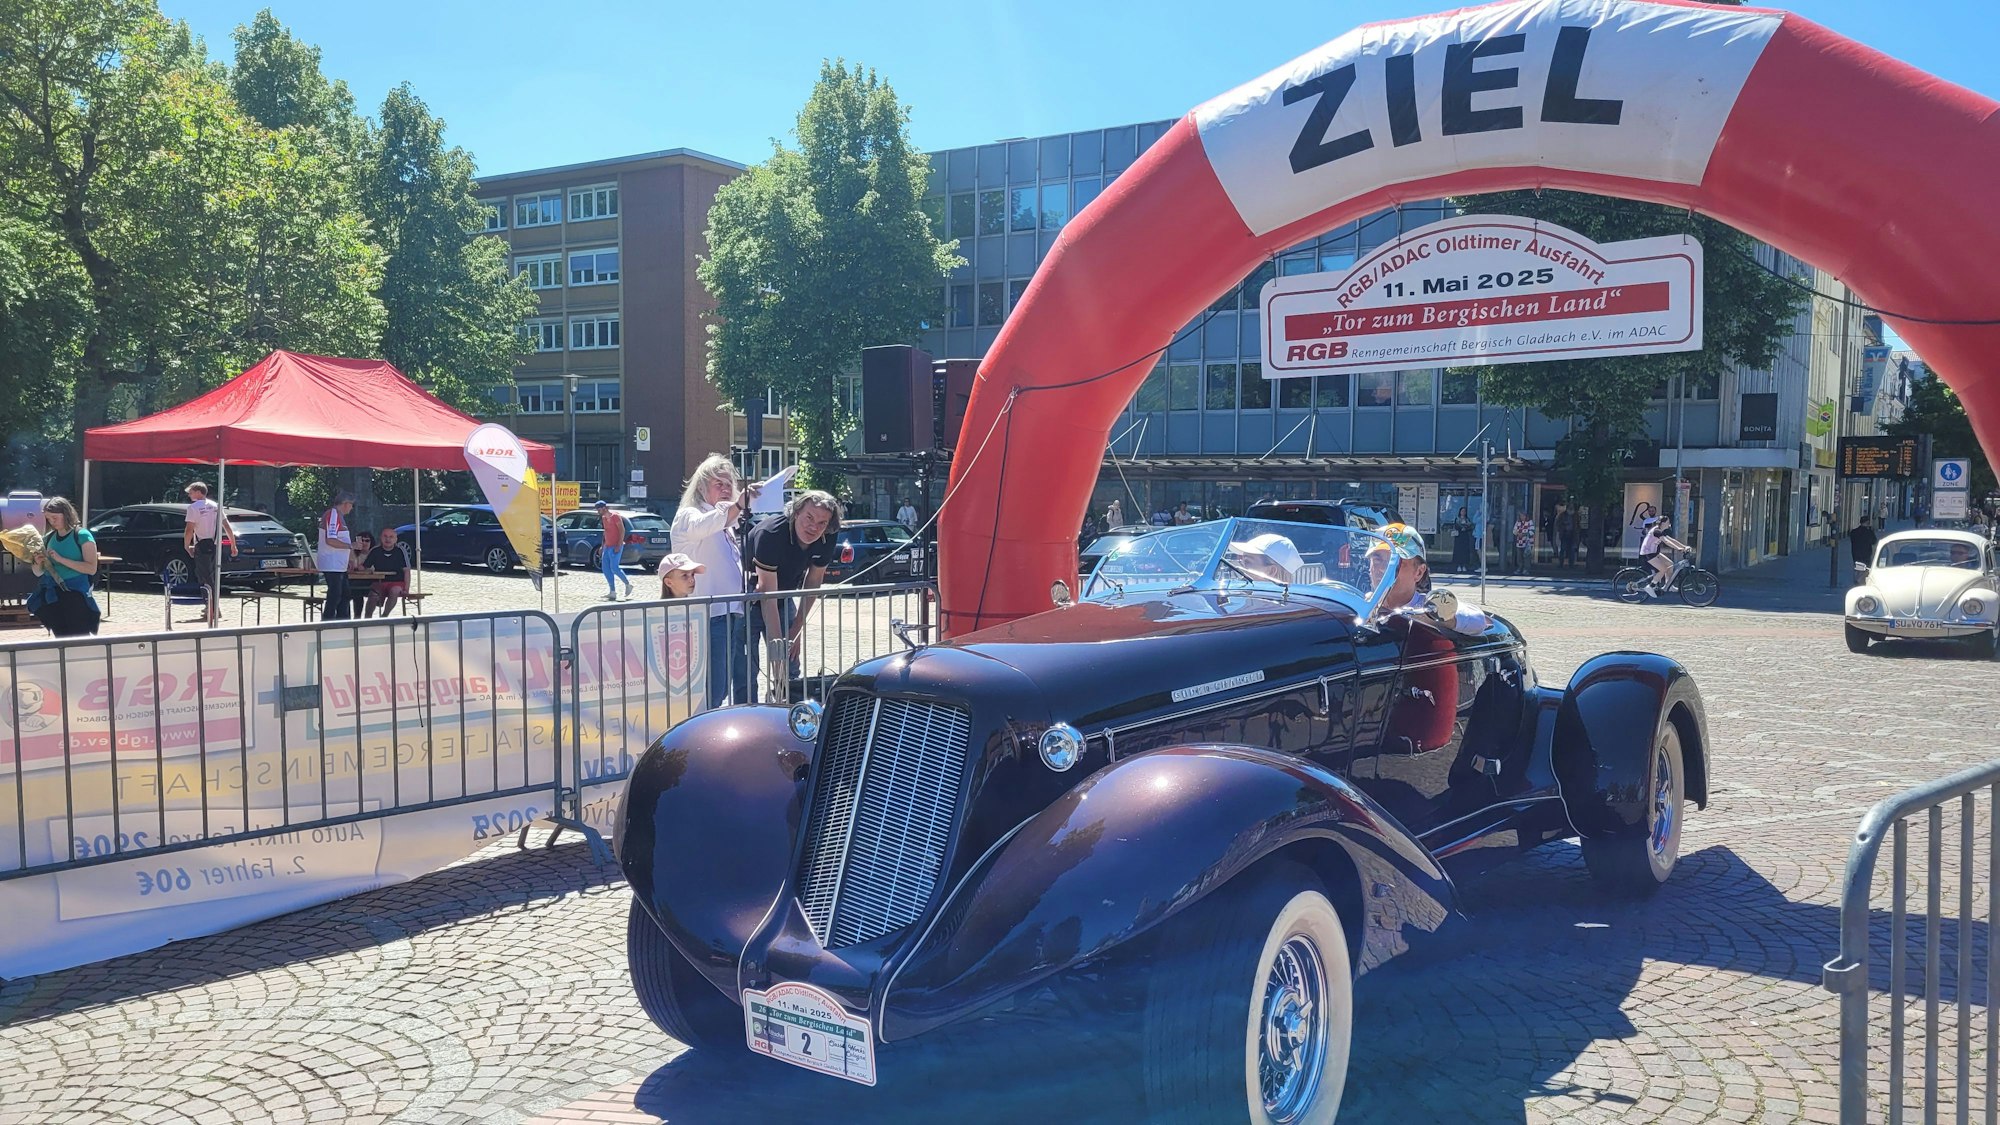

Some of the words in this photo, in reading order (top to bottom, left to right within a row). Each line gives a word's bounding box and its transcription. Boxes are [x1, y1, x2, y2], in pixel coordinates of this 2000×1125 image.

[1282, 26, 1623, 174] ZIEL
[1336, 243, 1432, 309] RGB/ADAC
[1436, 234, 1521, 254] Oldtimer
[1524, 239, 1605, 286] Ausfahrt
[1383, 281, 1415, 298] 11.
[1423, 275, 1468, 295] Mai
[1477, 268, 1554, 290] 2025
[1372, 312, 1414, 329] zum
[1421, 300, 1540, 327] Bergischen
[1287, 341, 1348, 362] RGB
[1351, 340, 1457, 360] Renngemeinschaft
[1461, 336, 1512, 351] Bergisch
[1517, 331, 1576, 346] Gladbach
[1580, 330, 1602, 341] e.V.
[1608, 329, 1624, 339] im
[1628, 325, 1667, 338] ADAC
[778, 1000, 790, 1009] 11.
[792, 1004, 807, 1014] Mai
[810, 1008, 832, 1020] 2025
[798, 1016, 834, 1032] Bergischen
[801, 1032, 812, 1056] 2
